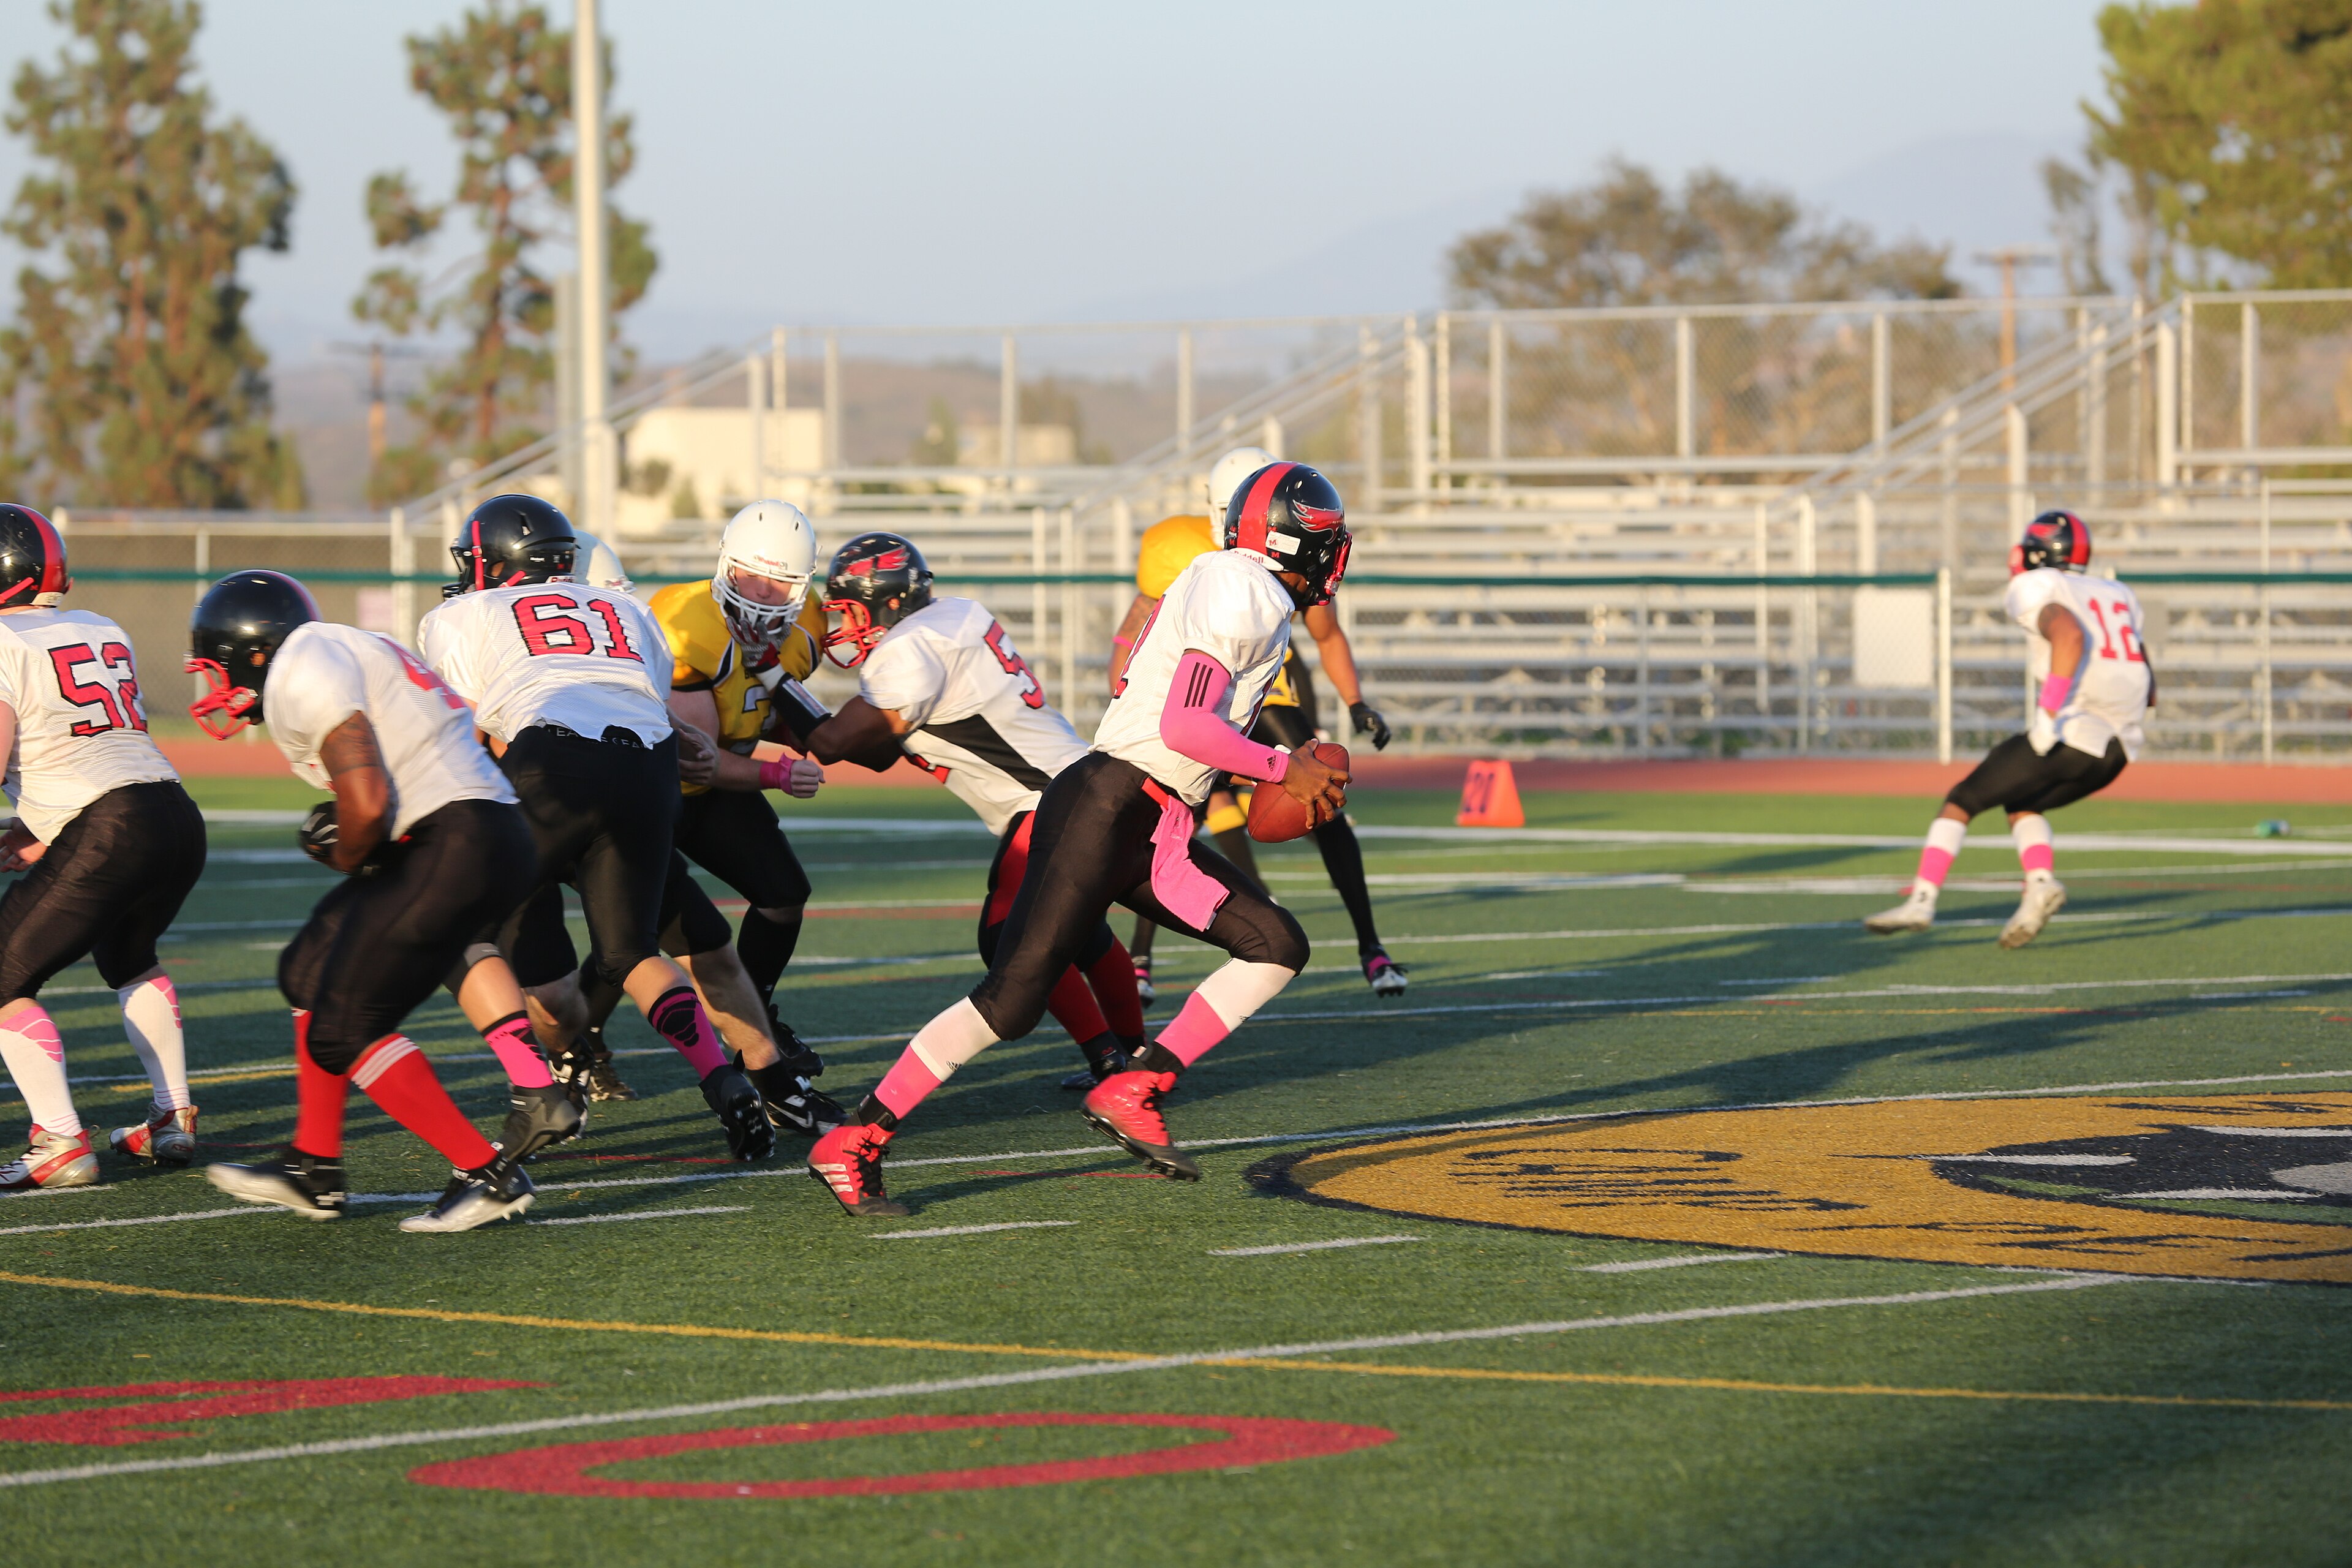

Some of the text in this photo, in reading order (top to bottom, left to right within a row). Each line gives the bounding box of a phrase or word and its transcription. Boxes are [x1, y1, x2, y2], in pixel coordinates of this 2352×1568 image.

[511, 594, 646, 665] 61
[983, 619, 1044, 709] 5
[2088, 598, 2147, 662] 12
[47, 641, 148, 737] 52
